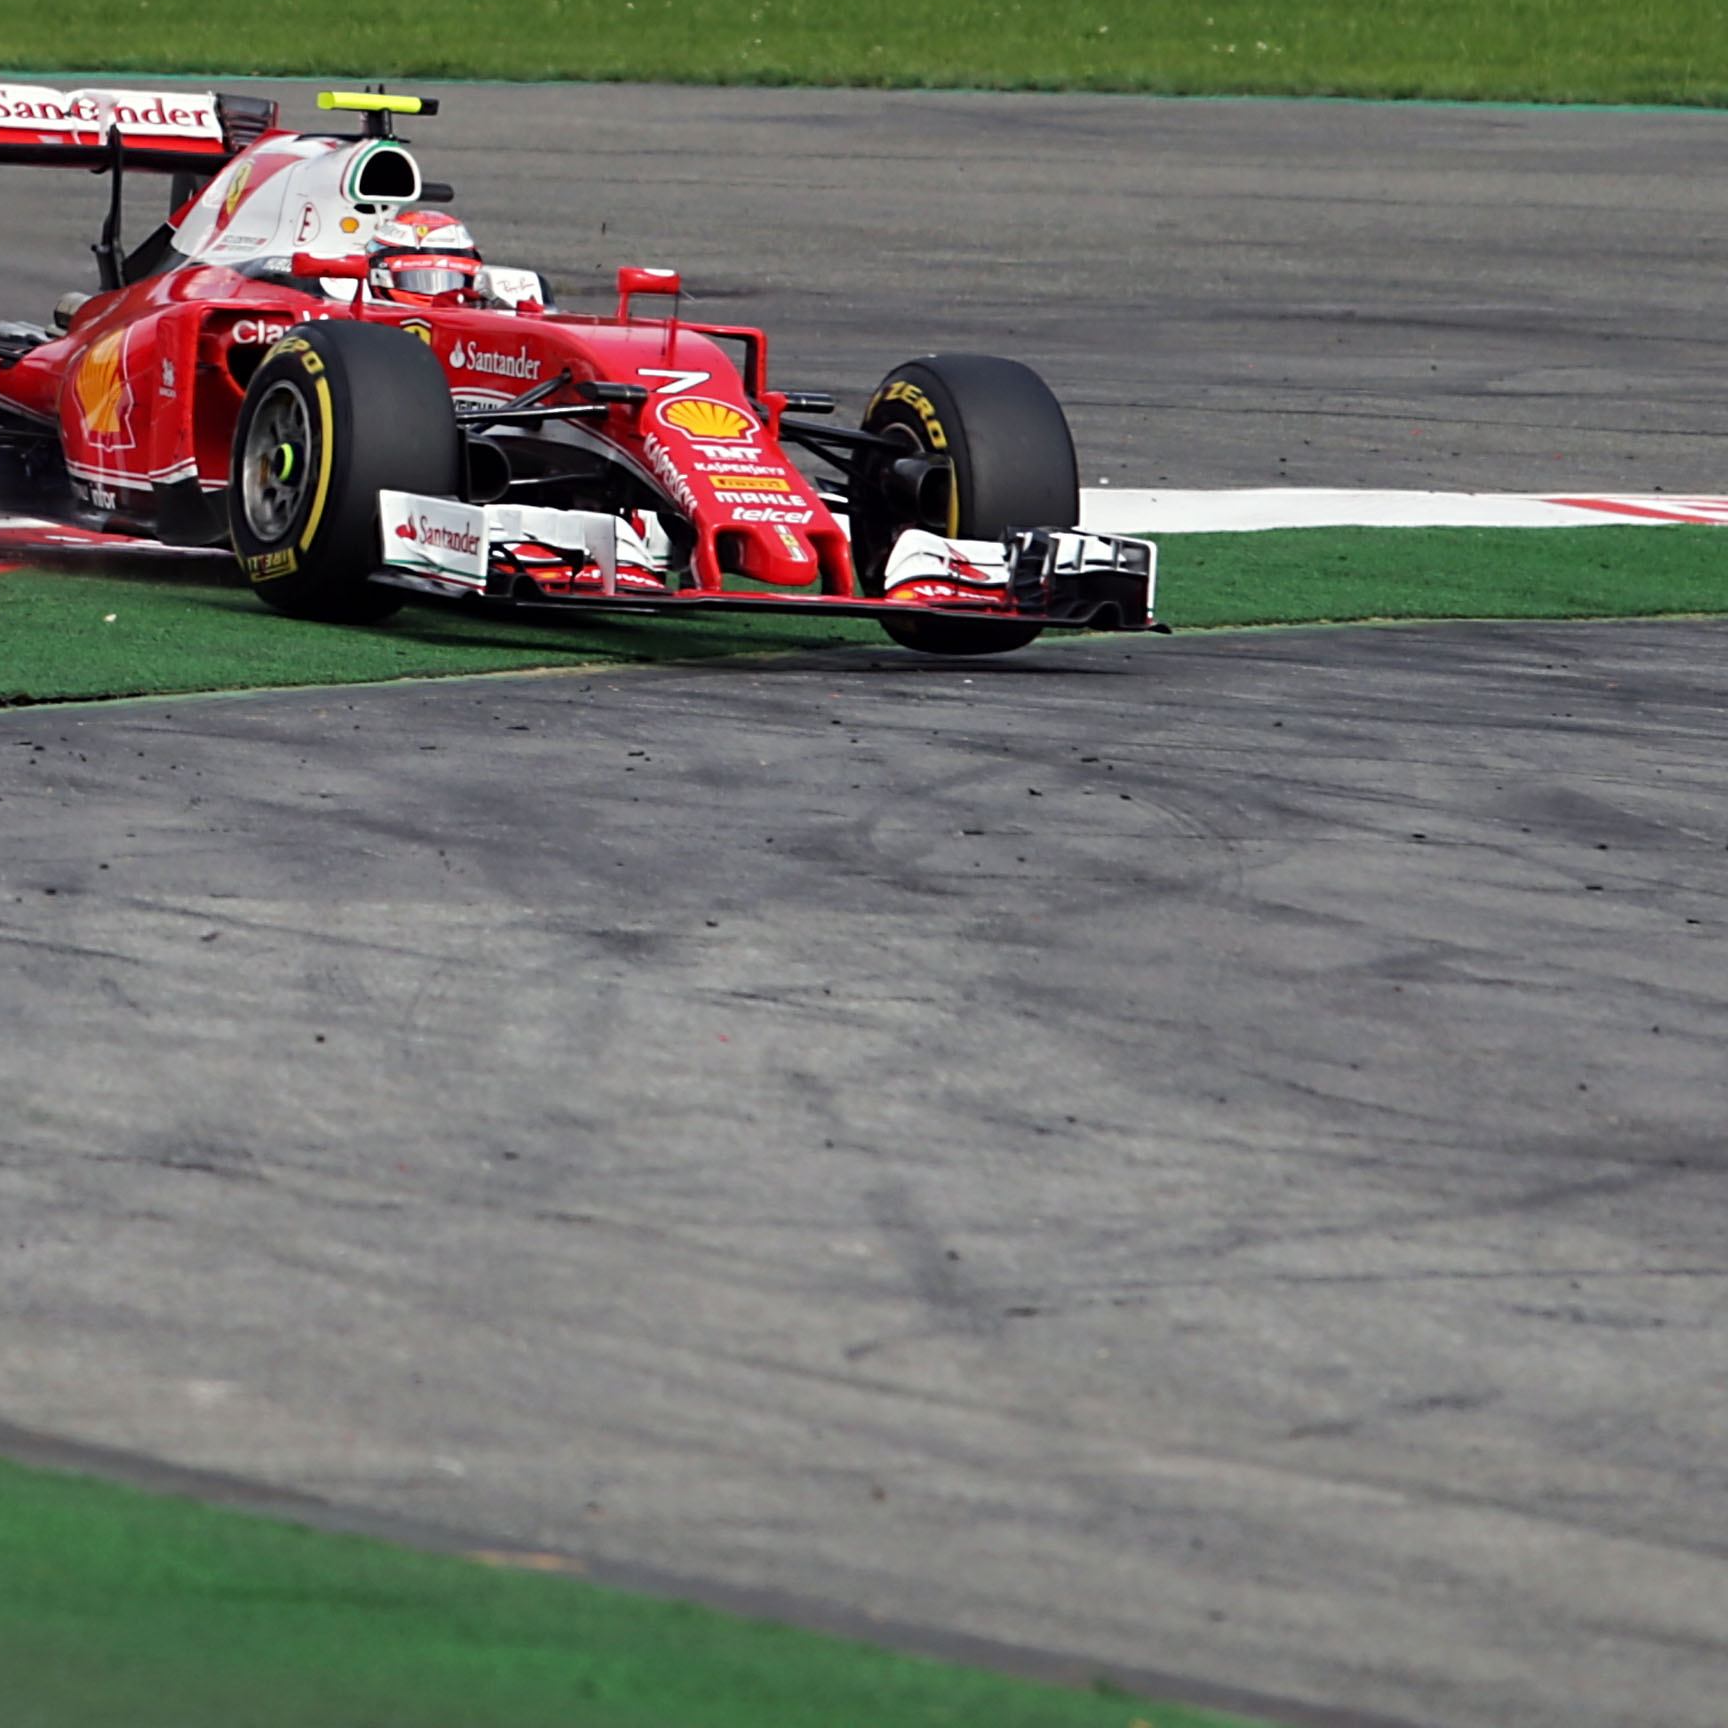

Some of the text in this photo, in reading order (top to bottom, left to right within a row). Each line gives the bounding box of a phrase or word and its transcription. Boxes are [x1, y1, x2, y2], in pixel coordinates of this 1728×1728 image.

[466, 340, 542, 380] Santander
[637, 367, 712, 394] 7
[691, 444, 762, 460] TNT
[713, 490, 808, 507] MAHLE
[731, 506, 815, 524] telcel
[419, 515, 481, 556] Santander
